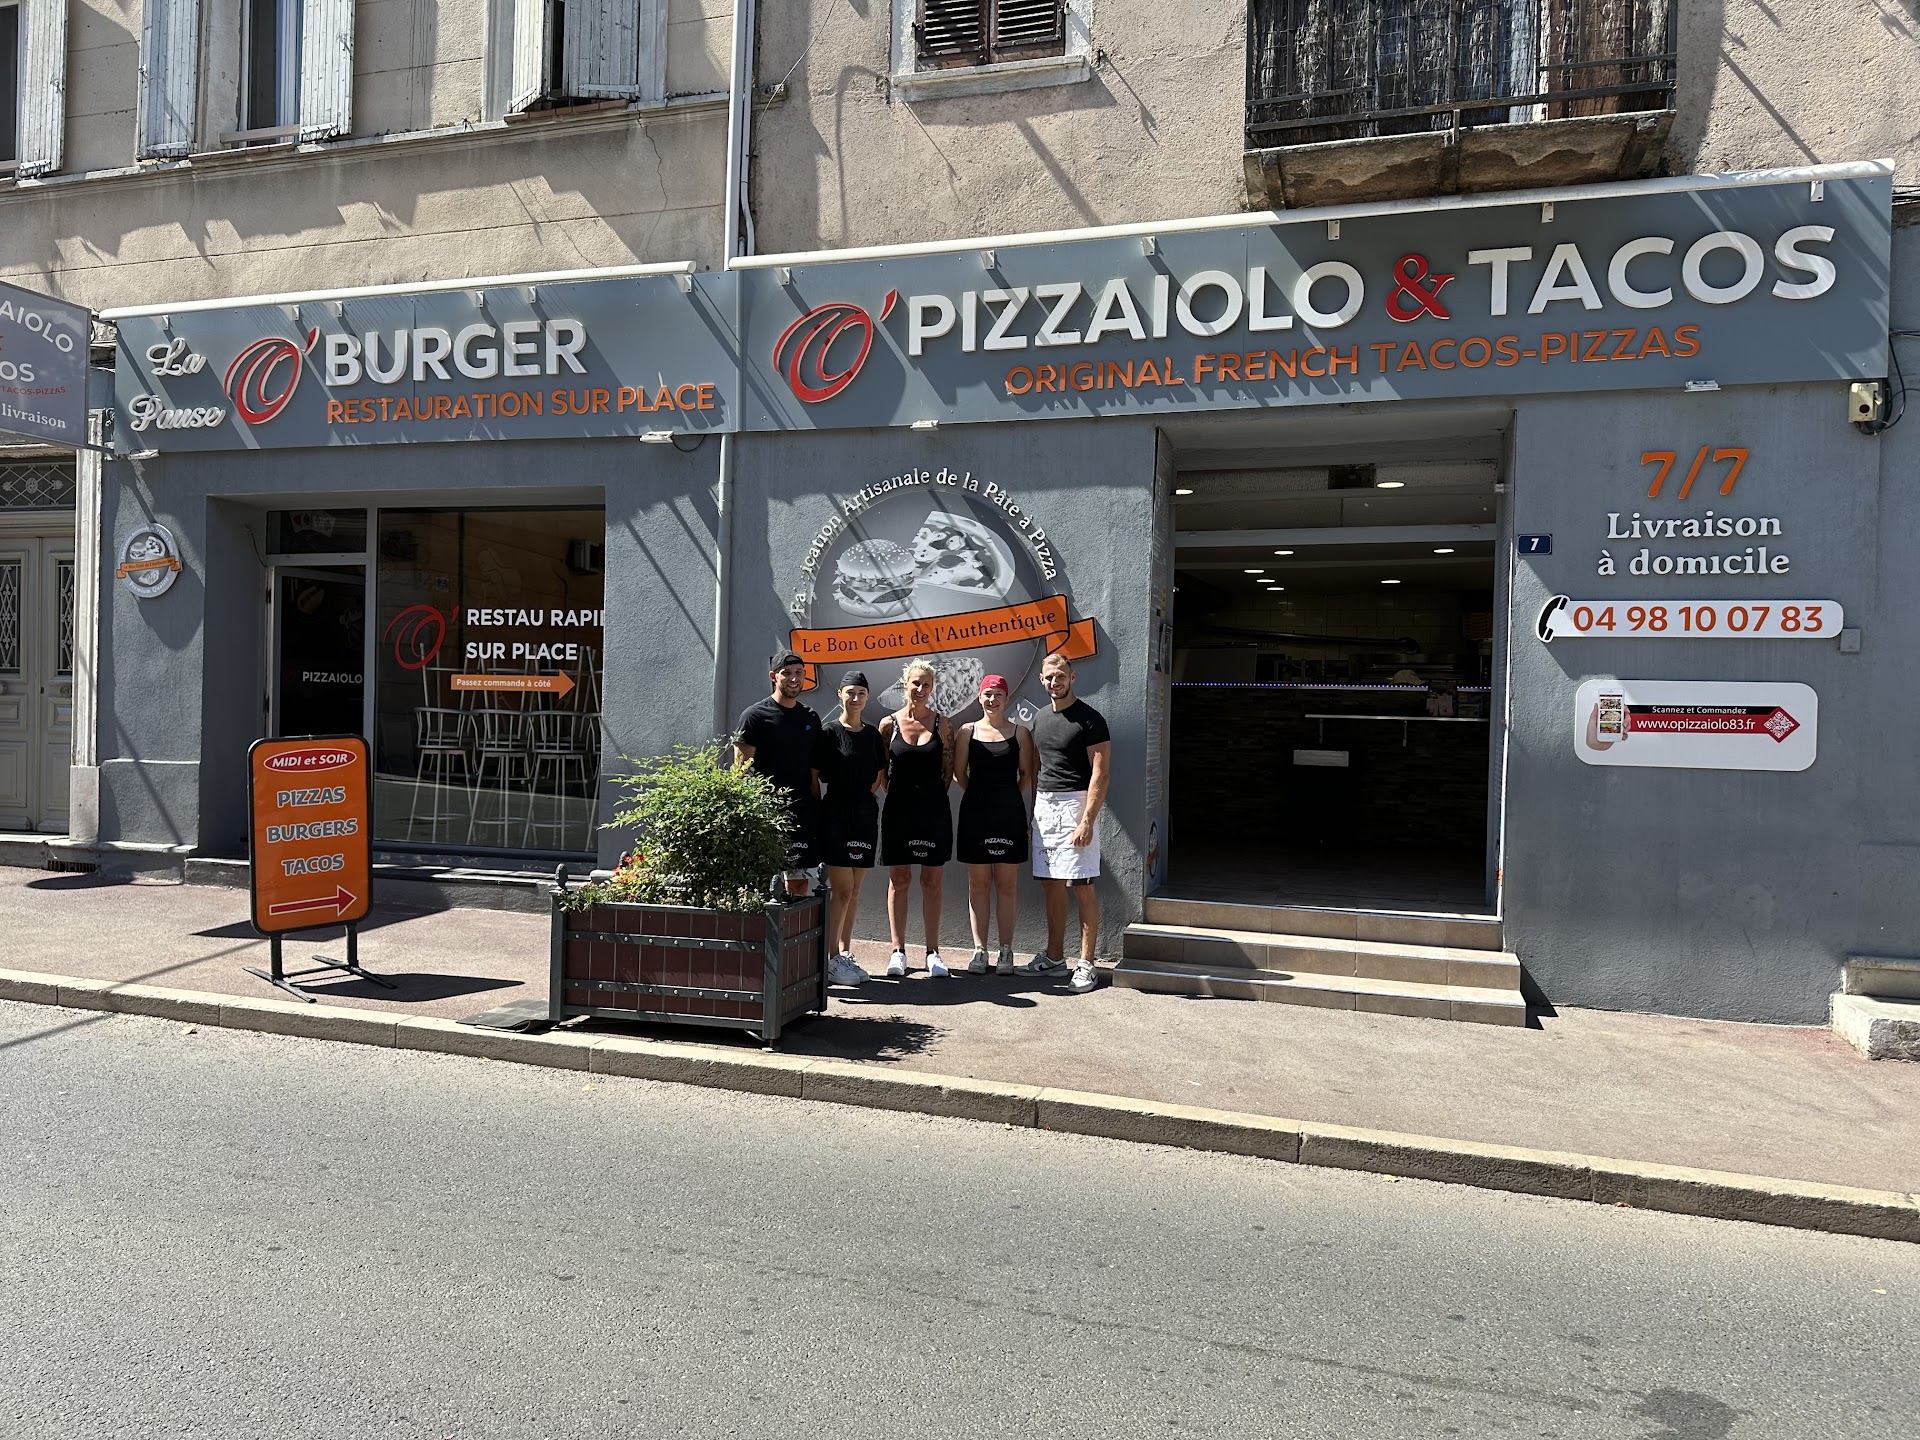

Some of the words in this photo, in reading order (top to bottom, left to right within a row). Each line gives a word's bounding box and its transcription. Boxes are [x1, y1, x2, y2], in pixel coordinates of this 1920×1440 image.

[1385, 254, 1456, 323] &
[1468, 224, 1837, 317] TACOS
[0, 300, 73, 353] AIOLO
[146, 337, 207, 377] La
[1006, 357, 1185, 395] ORIGINAL
[1194, 345, 1359, 384] FRENCH
[1370, 325, 1700, 374] TACOS-PIZZAS
[1, 402, 67, 429] livraison
[128, 394, 226, 432] Pause
[327, 391, 543, 424] RESTAURATION
[551, 387, 610, 415] SUR
[618, 383, 715, 412] PLACE
[1641, 446, 1750, 500] 7/7
[842, 467, 930, 516] Artisanale
[936, 467, 958, 486] de
[962, 472, 979, 492] la
[983, 481, 1020, 517] Pâte
[1019, 515, 1033, 530] à
[1028, 526, 1057, 580] Pizza
[1607, 510, 1782, 540] Livraison
[1529, 537, 1541, 551] 7
[1598, 550, 1616, 576] à
[1629, 546, 1790, 576] domicile
[467, 608, 544, 626] RESTAU
[1573, 605, 1616, 631] 04
[1626, 605, 1668, 631] 98
[1679, 605, 1716, 631] 10
[1727, 605, 1770, 631] 07
[1780, 606, 1823, 632] 83
[802, 638, 821, 653] Le
[827, 637, 858, 652] Bon
[864, 633, 904, 650] Goût
[911, 631, 930, 646] de
[935, 612, 1057, 642] l'Authentique
[466, 642, 506, 659] SUR
[512, 643, 578, 660] PLACE
[302, 671, 363, 684] PIZZAIOLO
[456, 678, 481, 686] Passez
[483, 679, 525, 687] commande
[527, 679, 532, 687] à
[533, 679, 551, 687] côté
[1652, 706, 1685, 714] Scannez
[1686, 706, 1695, 714] et
[1697, 706, 1747, 715] Commandez
[1637, 718, 1756, 732] www.opizzaiolo83.fr
[271, 756, 302, 768] MIDI
[304, 756, 317, 766] et
[319, 753, 348, 765] SOIR
[277, 786, 345, 808] PIZZAS
[266, 818, 358, 844] BURGERS
[984, 837, 1014, 846] PIZZAIOLO
[792, 841, 809, 849] AIOLO
[846, 840, 872, 850] PIZZAIOLO
[908, 839, 936, 849] PIZZAIOLO
[281, 854, 344, 877] TACOS
